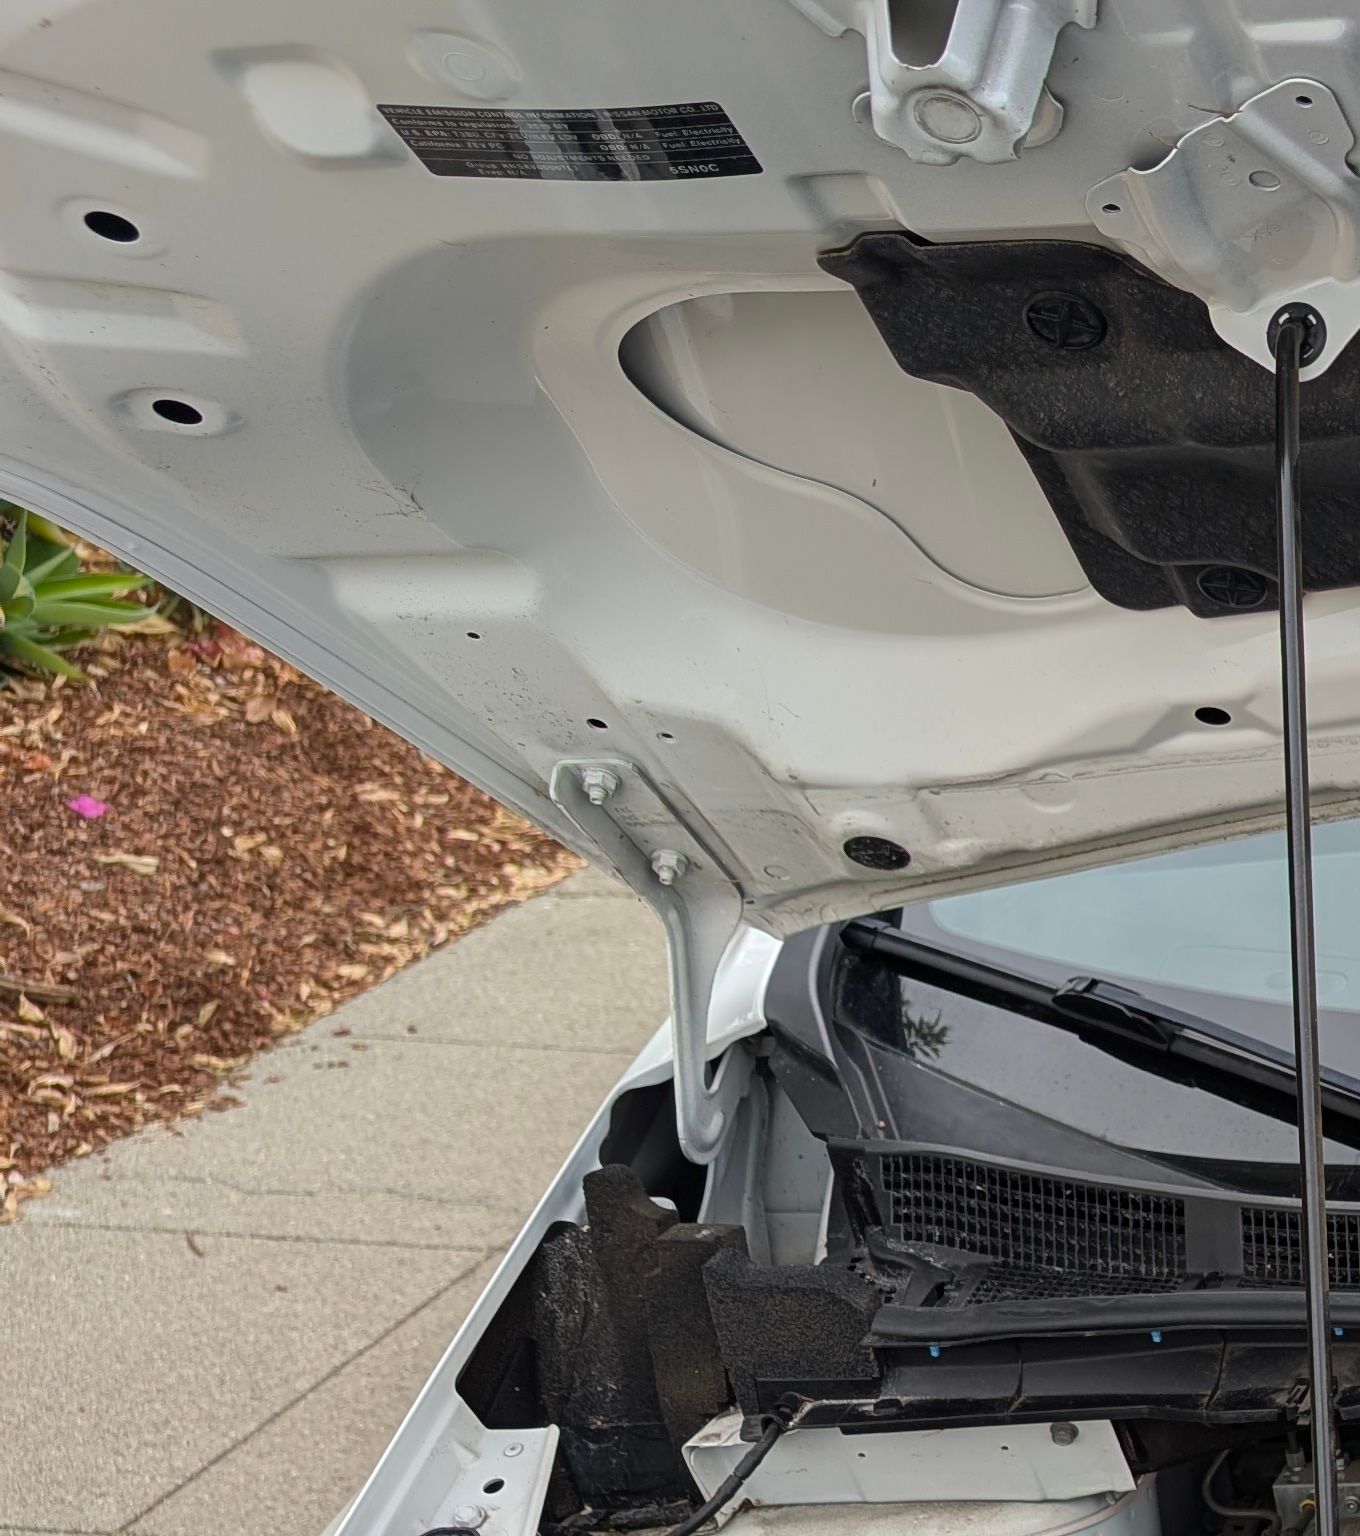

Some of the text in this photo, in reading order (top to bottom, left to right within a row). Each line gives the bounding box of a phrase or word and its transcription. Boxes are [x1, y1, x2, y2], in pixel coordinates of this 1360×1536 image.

[383, 108, 425, 116] VEHICLE
[426, 109, 476, 117] EMISSION
[478, 111, 525, 119] CONTROL
[640, 107, 677, 116] MOTOR
